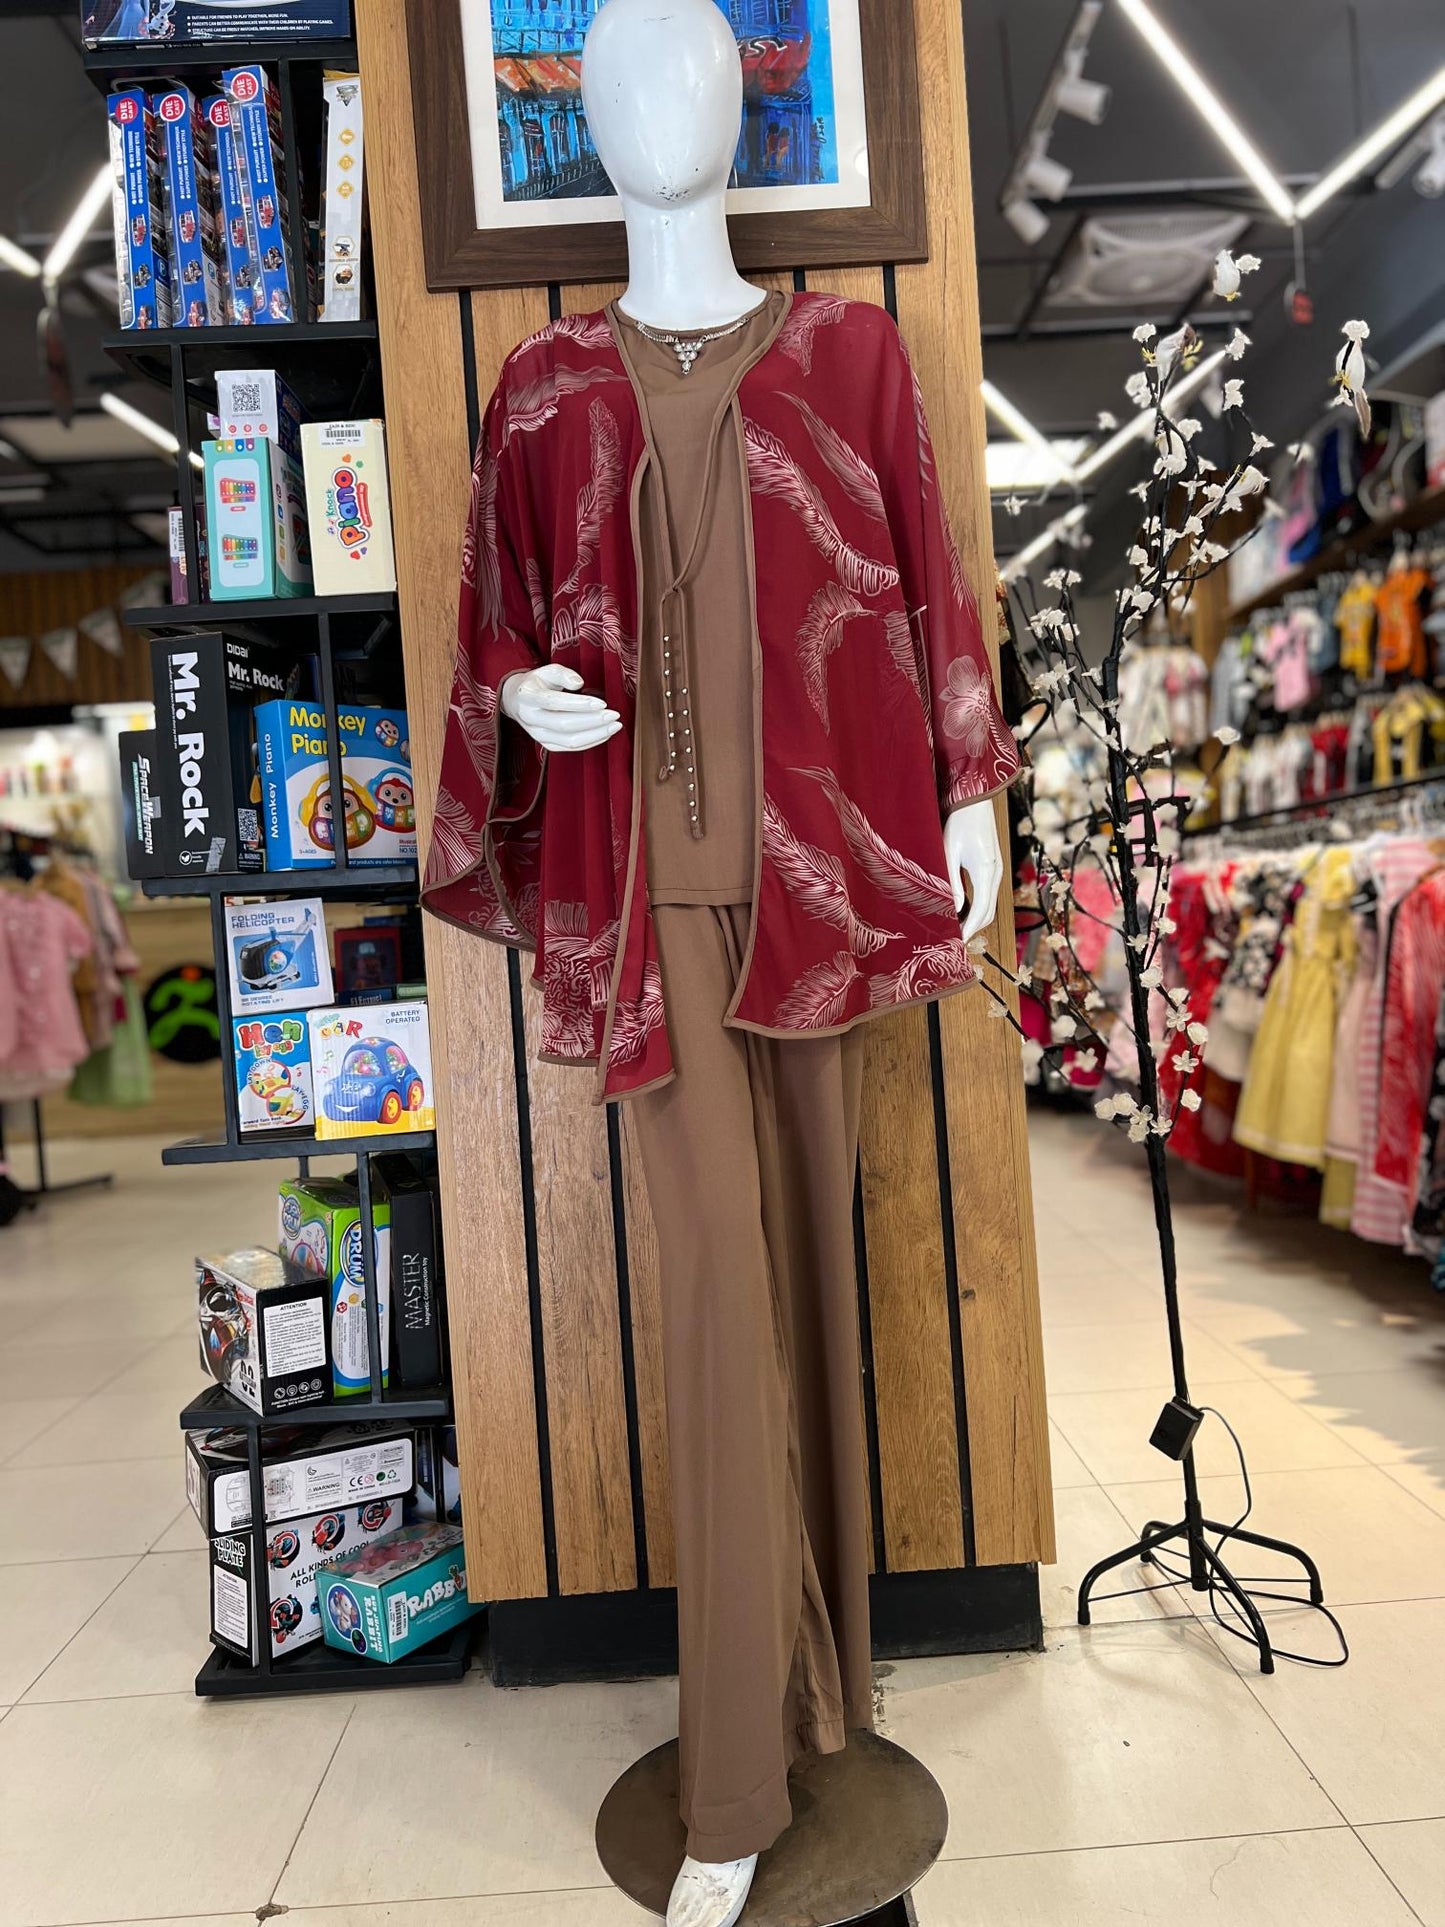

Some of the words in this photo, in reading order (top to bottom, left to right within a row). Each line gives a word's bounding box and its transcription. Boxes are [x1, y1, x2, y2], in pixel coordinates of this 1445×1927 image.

[237, 79, 246, 96] DIE
[246, 78, 254, 96] CAST
[166, 100, 174, 117] DIE
[215, 105, 224, 123] DIE
[326, 489, 335, 517] Knock
[228, 661, 250, 682] Mr.
[253, 668, 284, 692] Rock
[172, 652, 200, 720] Mr.
[264, 733, 273, 774] Piano
[178, 732, 209, 838] Rock
[268, 782, 279, 838] Monkey
[231, 912, 274, 922] FOLDING
[232, 916, 295, 929] HELICOPTER
[321, 1020, 363, 1038] CAR
[386, 1016, 420, 1025] OPERATED
[238, 1020, 302, 1049] Hen
[272, 1040, 293, 1053] egg
[251, 1059, 271, 1071] DOWN
[350, 1227, 363, 1281] DRUM
[402, 1253, 423, 1328] MASTER
[313, 1482, 340, 1492] WARNING
[350, 1476, 363, 1487] CE
[214, 1538, 246, 1556] SLIDING
[218, 1550, 244, 1566] PLATE
[290, 1568, 306, 1580] ALL
[308, 1556, 333, 1574] KINDS
[336, 1551, 347, 1562] OF
[364, 1596, 378, 1652] RABBIT
